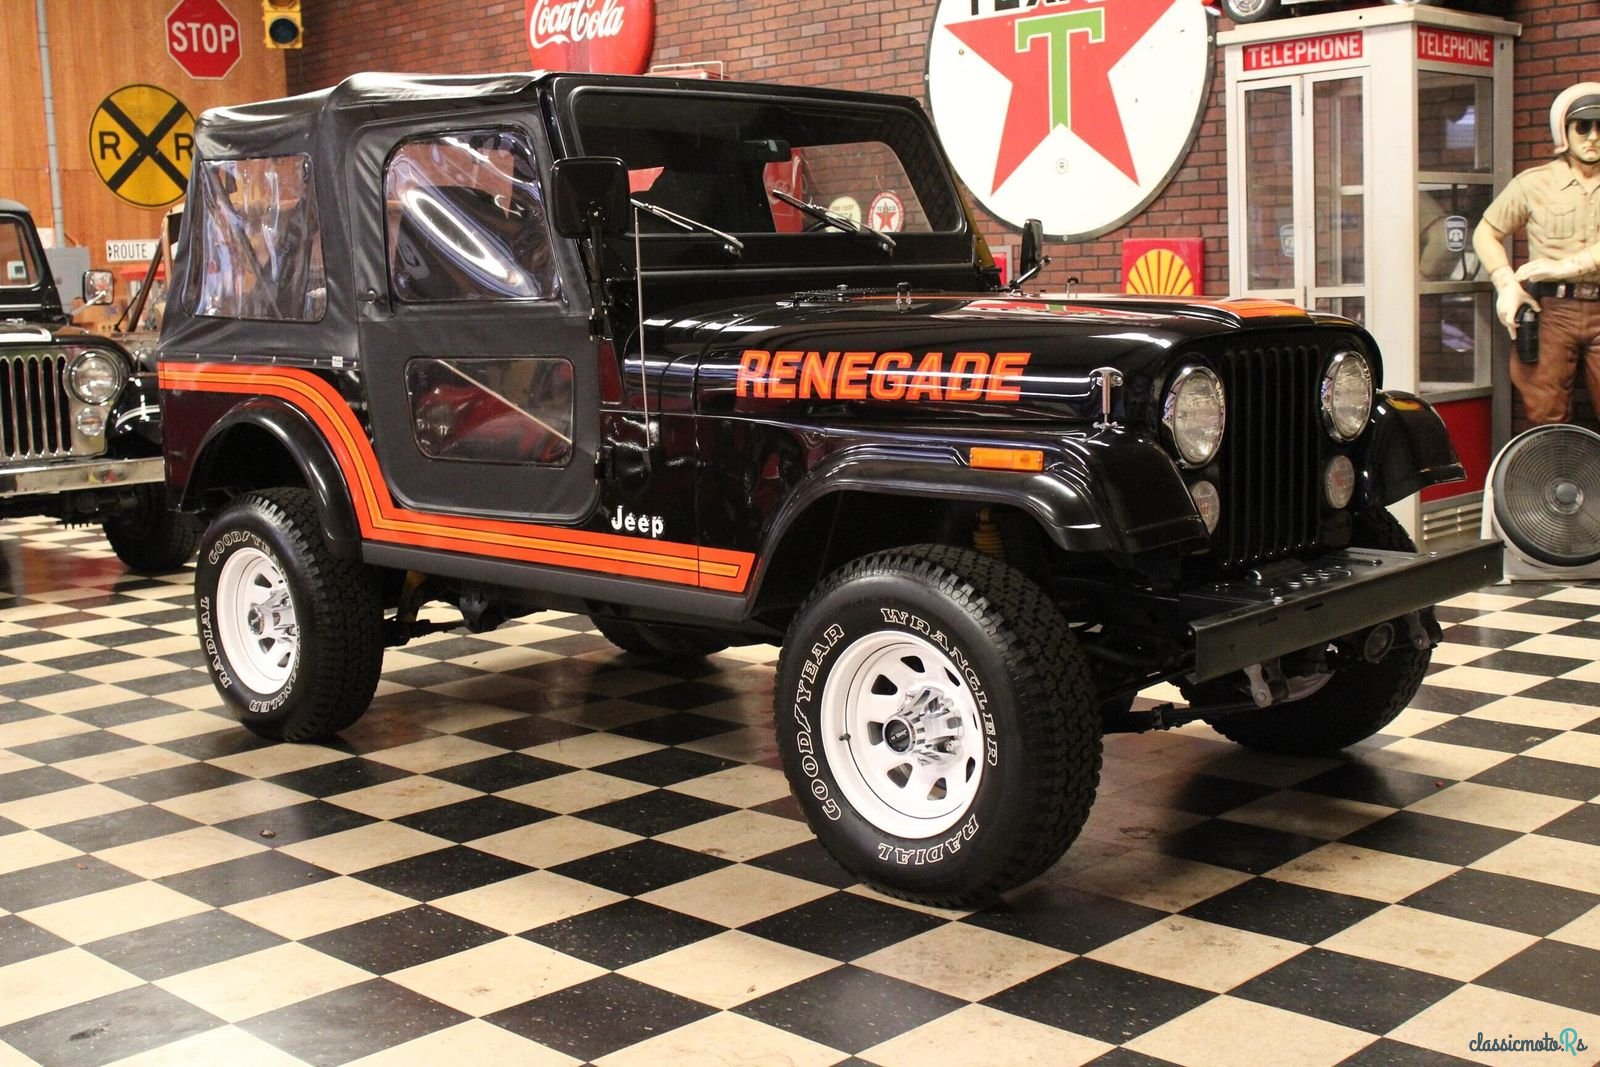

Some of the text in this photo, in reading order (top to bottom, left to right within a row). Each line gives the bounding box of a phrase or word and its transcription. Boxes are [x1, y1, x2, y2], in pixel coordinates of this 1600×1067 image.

[171, 21, 236, 54] STOP
[1247, 34, 1361, 69] TELEPHONE
[1418, 31, 1490, 62] TELEPHONE
[98, 130, 195, 161] R R
[113, 243, 148, 259] ROUTE
[736, 349, 1032, 401] RENEGADE
[611, 504, 664, 538] Jeep
[199, 595, 233, 690] RADIAL
[880, 607, 998, 767] WRANGLER
[877, 813, 980, 865] RADIAL
